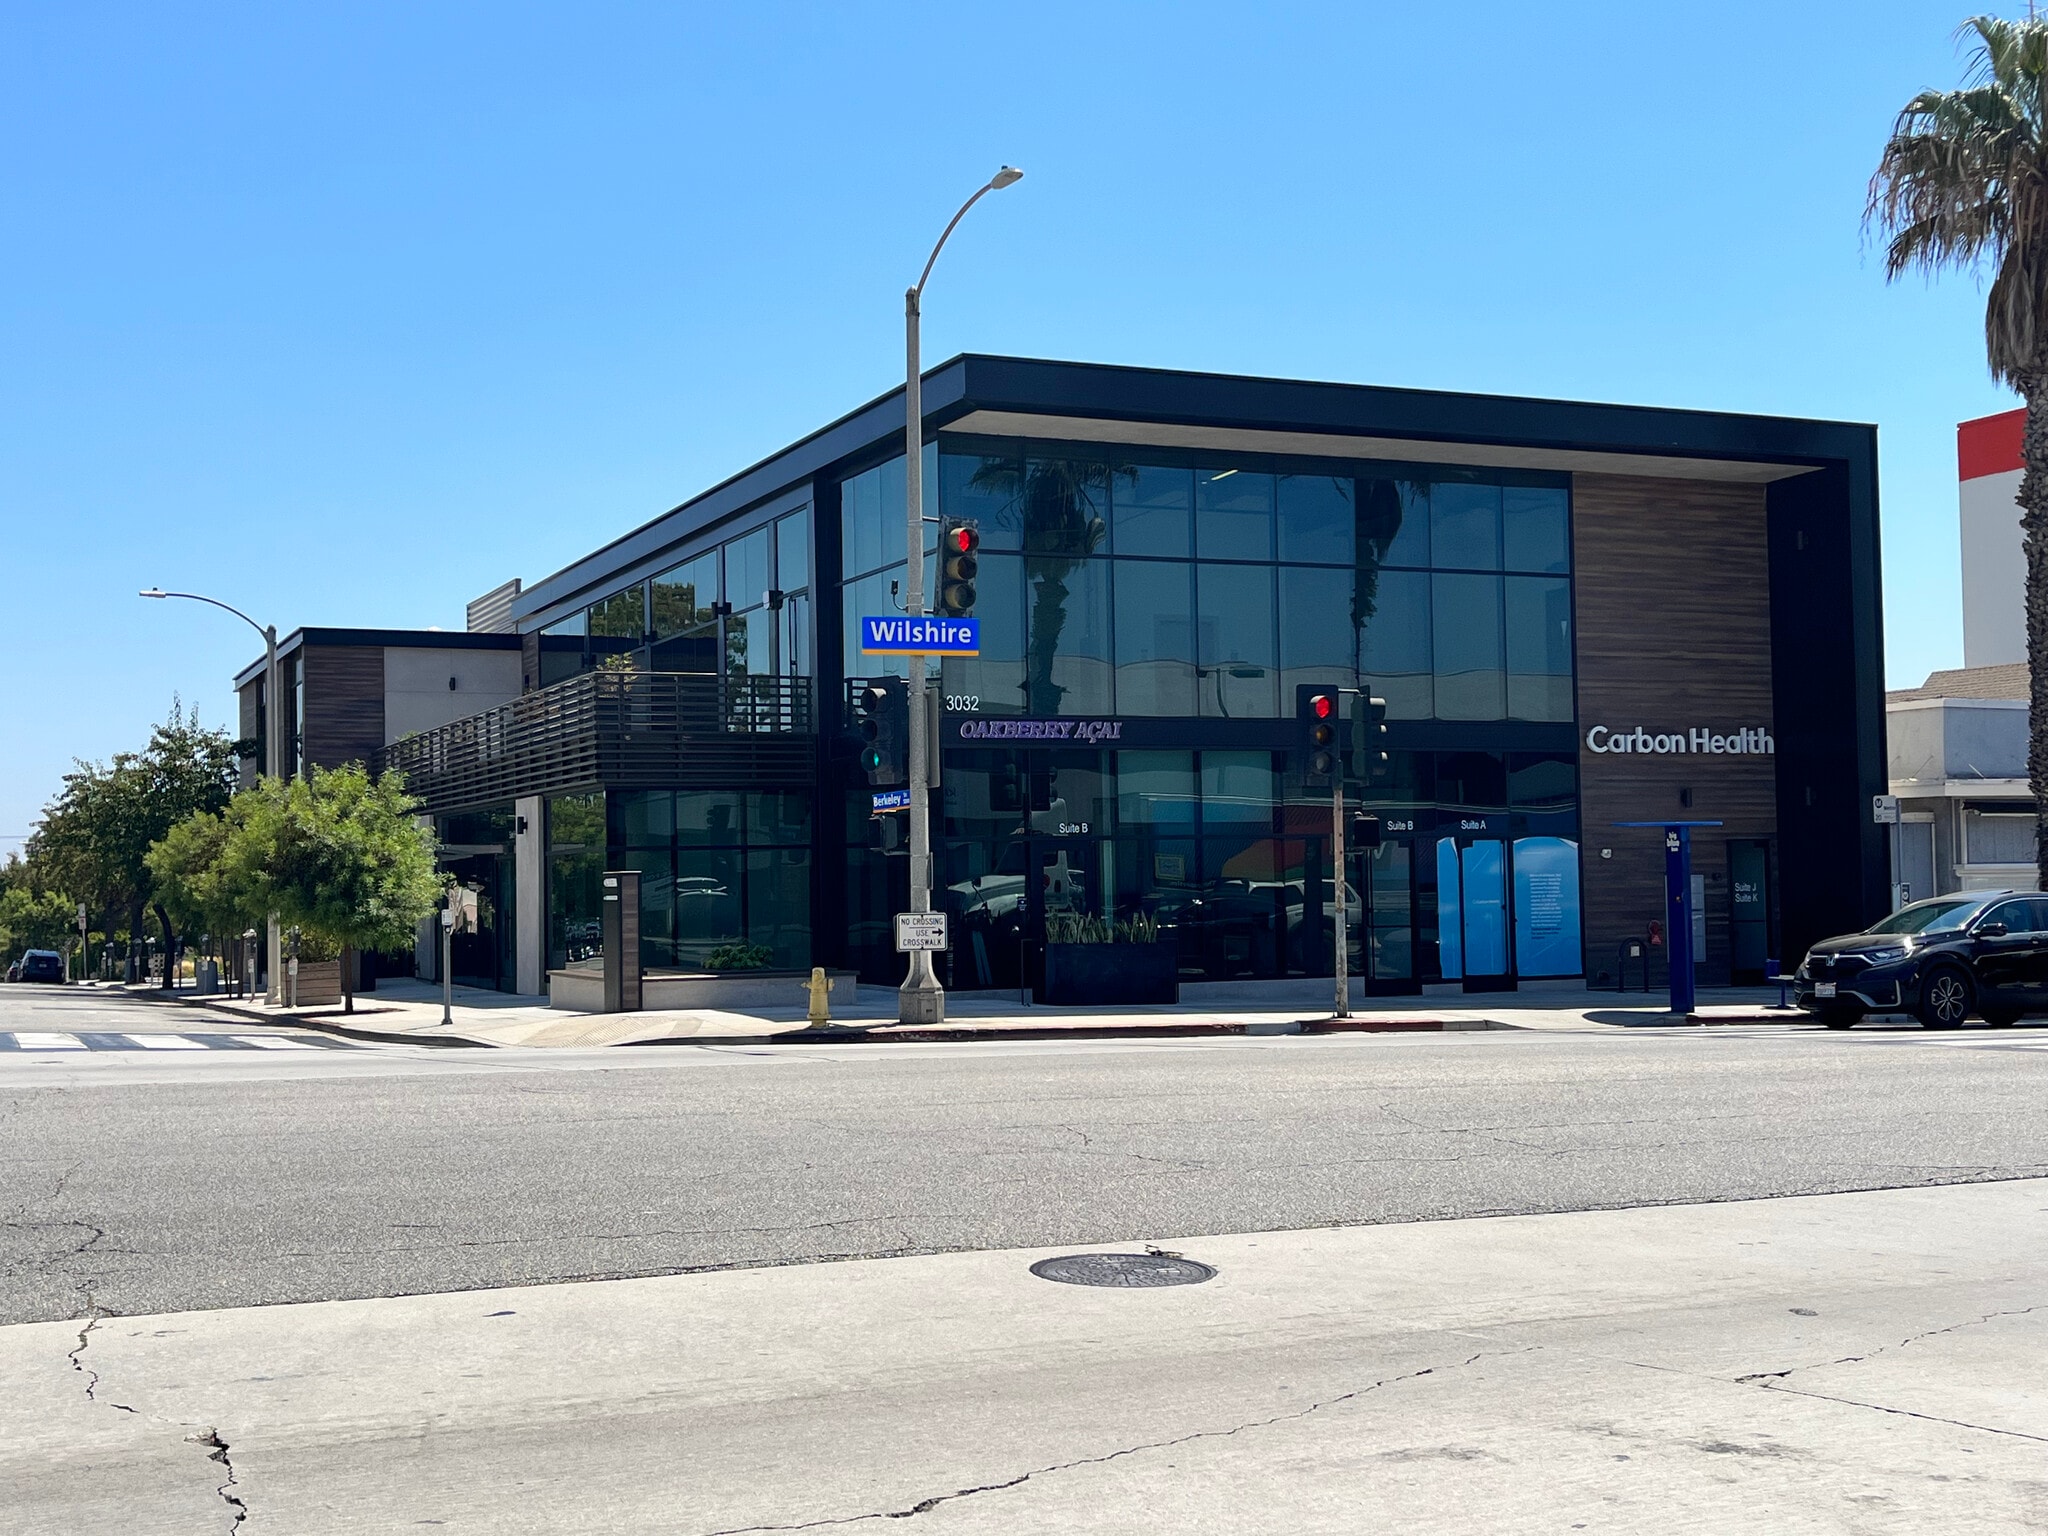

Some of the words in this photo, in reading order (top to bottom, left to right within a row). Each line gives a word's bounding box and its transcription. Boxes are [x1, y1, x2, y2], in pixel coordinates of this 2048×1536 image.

[870, 620, 972, 643] Wilshire
[946, 695, 980, 711] 3032
[960, 720, 1075, 739] OAKBERRY
[1074, 721, 1122, 744] AÇAI
[1586, 725, 1686, 754] Carbon
[1689, 727, 1775, 754] Health
[873, 793, 901, 807] Berkeley
[1059, 822, 1080, 834] Suite
[1081, 822, 1089, 833] B
[1387, 820, 1406, 831] Suite
[1407, 820, 1414, 831] B
[1461, 820, 1479, 830] Suite
[1480, 820, 1486, 830] A
[1735, 882, 1751, 892] Suite
[1752, 882, 1757, 892] J
[1735, 893, 1751, 902] Suite
[1752, 893, 1758, 902] K
[901, 918, 910, 926] NO
[912, 917, 943, 926] CROSSING
[915, 929, 929, 937] USE
[902, 938, 942, 947] CROSSWALK
